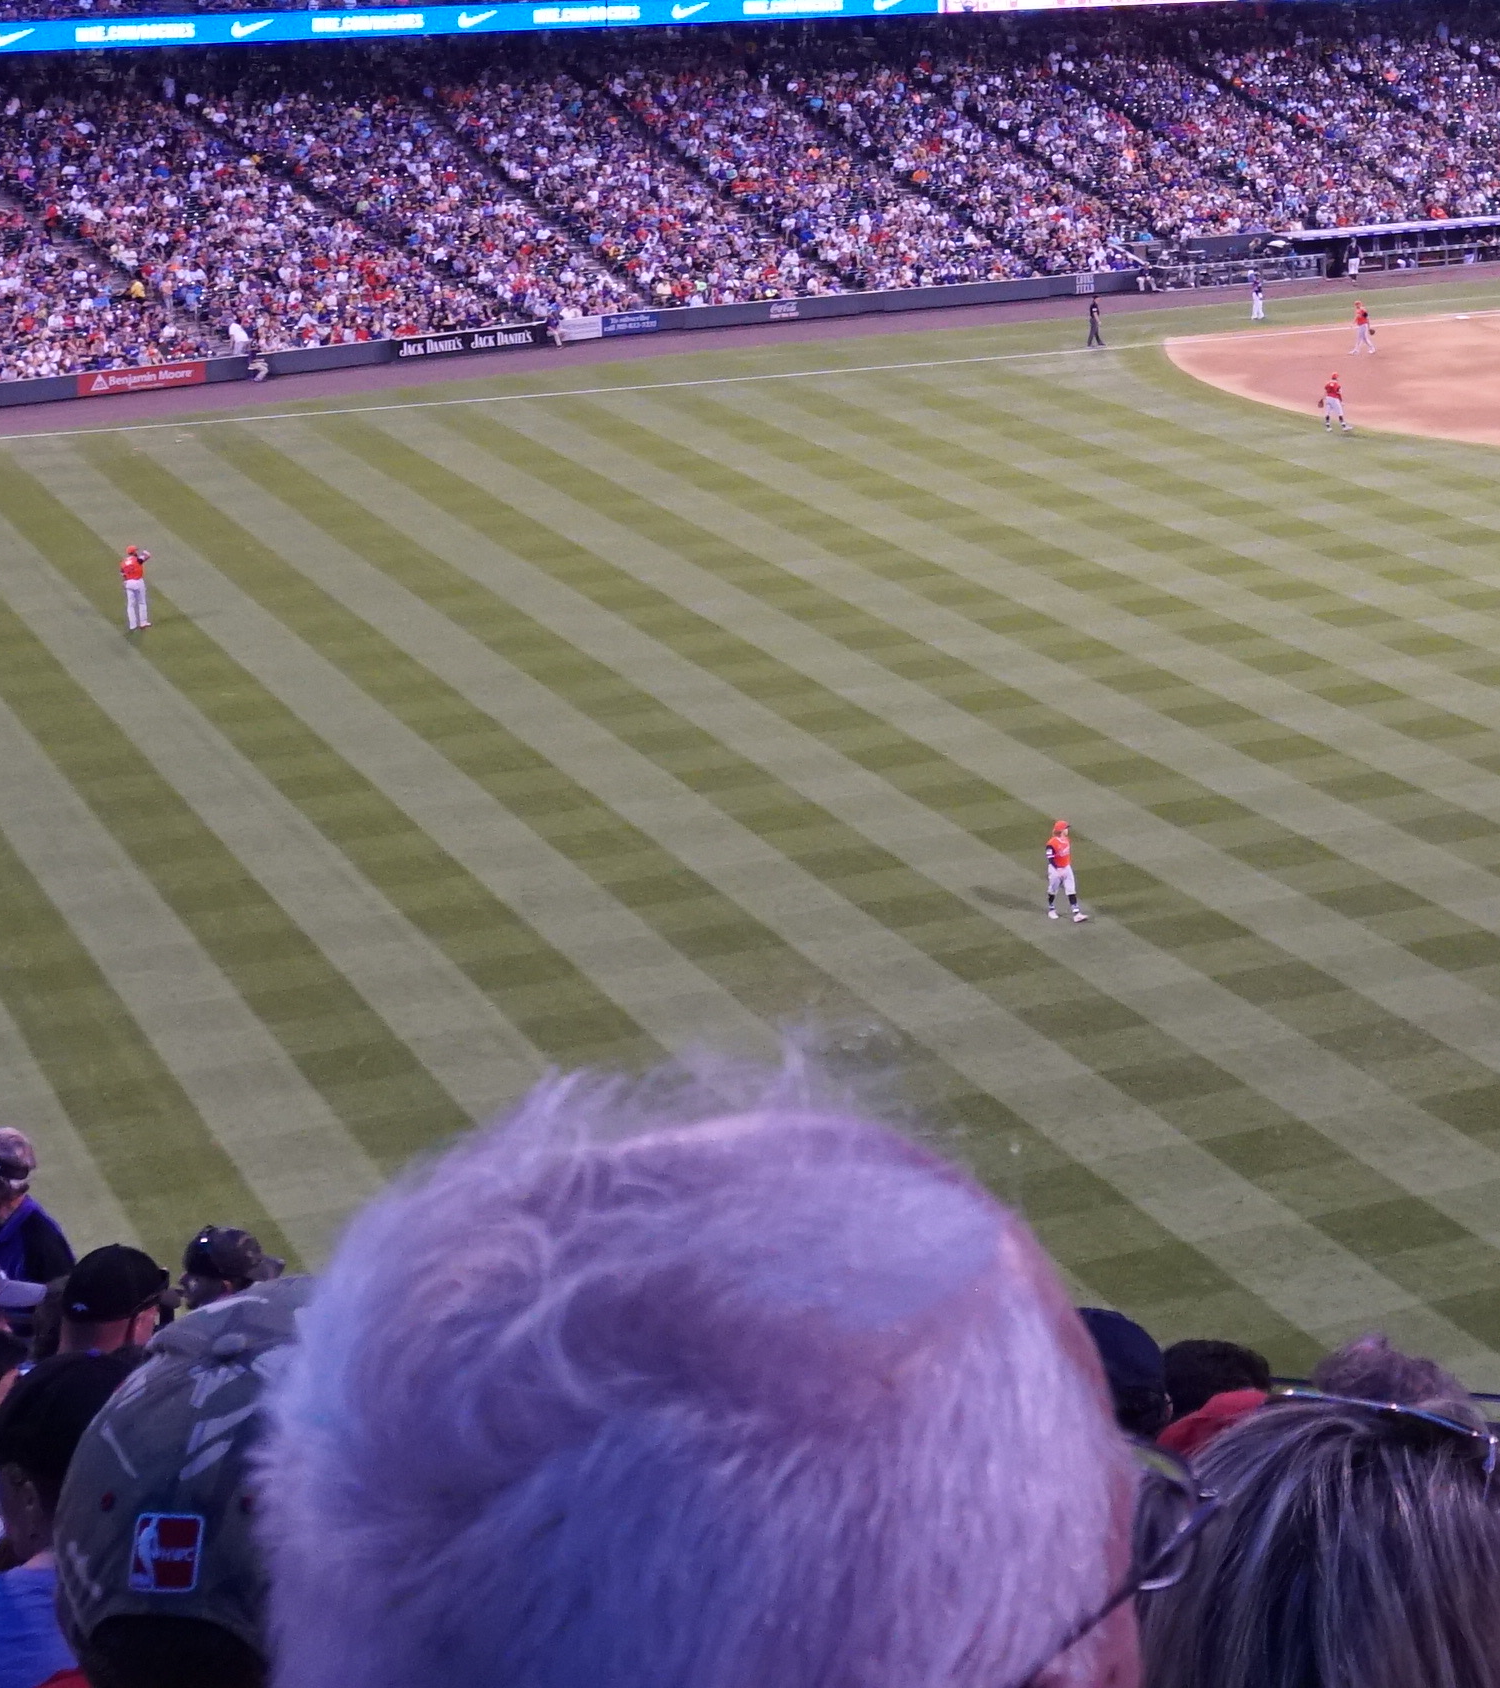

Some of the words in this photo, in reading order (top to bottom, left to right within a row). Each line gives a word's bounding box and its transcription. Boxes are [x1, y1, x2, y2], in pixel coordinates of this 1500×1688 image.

[400, 340, 424, 357] JACK
[426, 336, 463, 354] DANIEL'S
[471, 334, 495, 350] JACK
[496, 329, 533, 347] DANIEL'S
[108, 372, 157, 387] Benjamin
[158, 369, 193, 380] Moore
